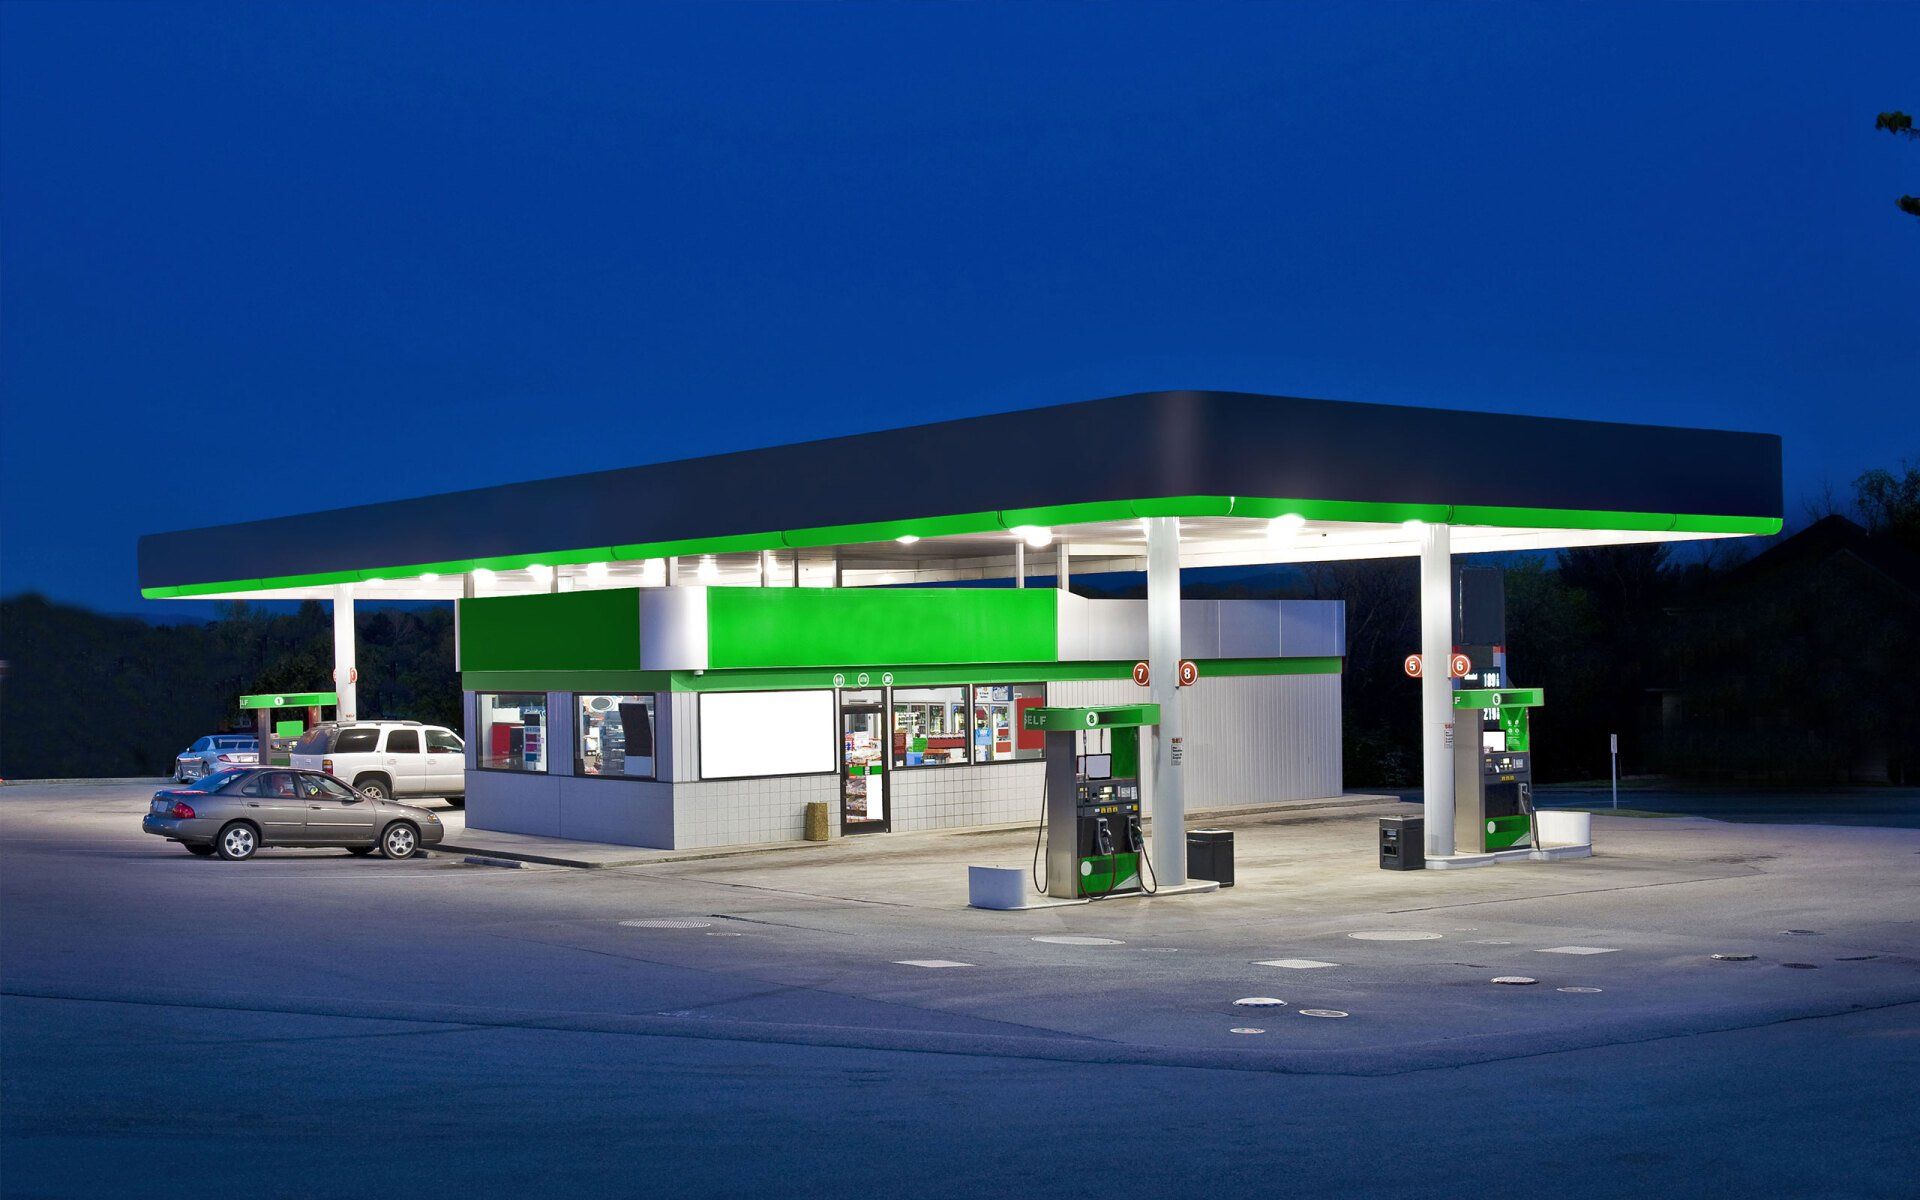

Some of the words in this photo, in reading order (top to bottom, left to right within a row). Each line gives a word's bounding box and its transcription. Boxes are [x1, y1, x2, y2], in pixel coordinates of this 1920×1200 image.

[1409, 661, 1416, 671] 5
[1456, 661, 1463, 671] 6
[1137, 668, 1144, 680] 7
[1184, 668, 1191, 680] 8
